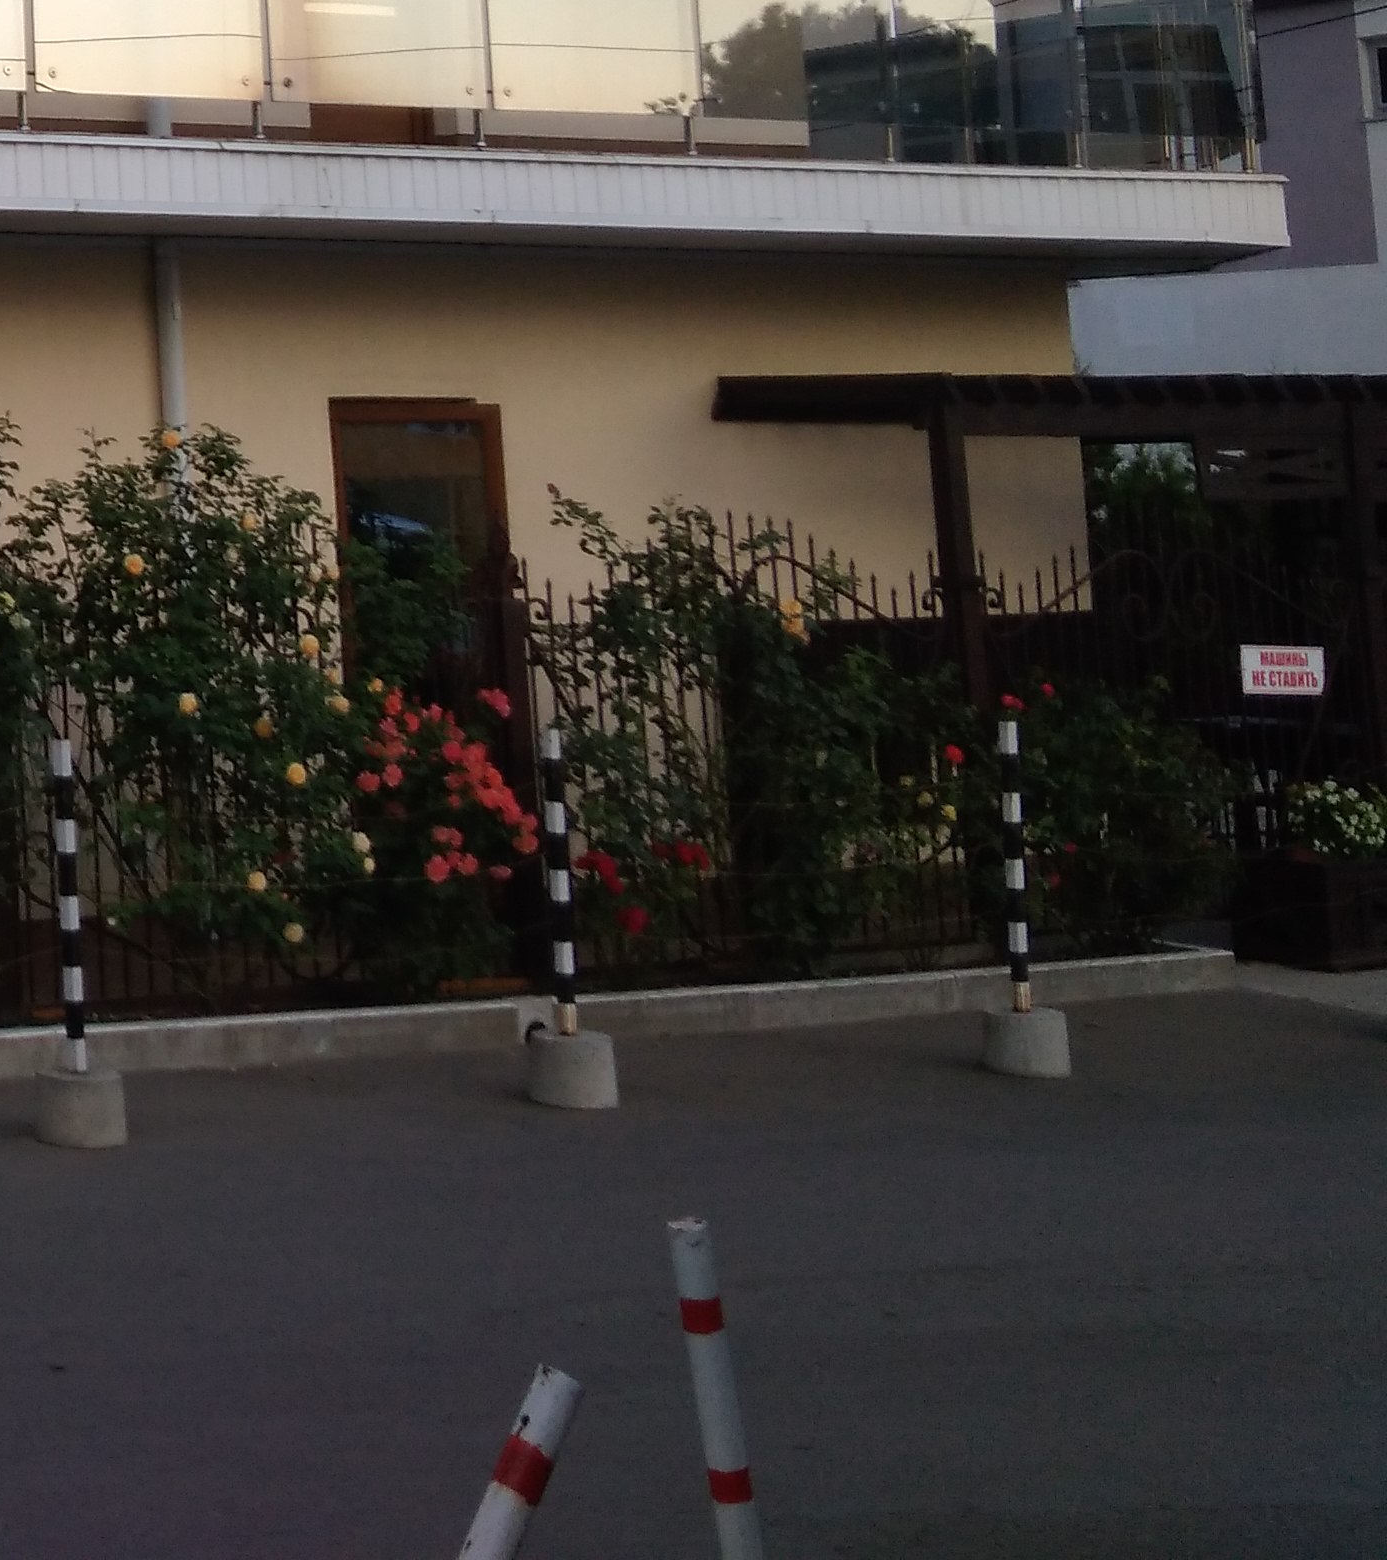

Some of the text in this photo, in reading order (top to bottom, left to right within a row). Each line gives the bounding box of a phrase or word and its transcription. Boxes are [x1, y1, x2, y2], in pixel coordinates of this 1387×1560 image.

[1259, 650, 1309, 666] МАШИНЫ
[1252, 670, 1318, 688] НЕ СТАВИТЬ
